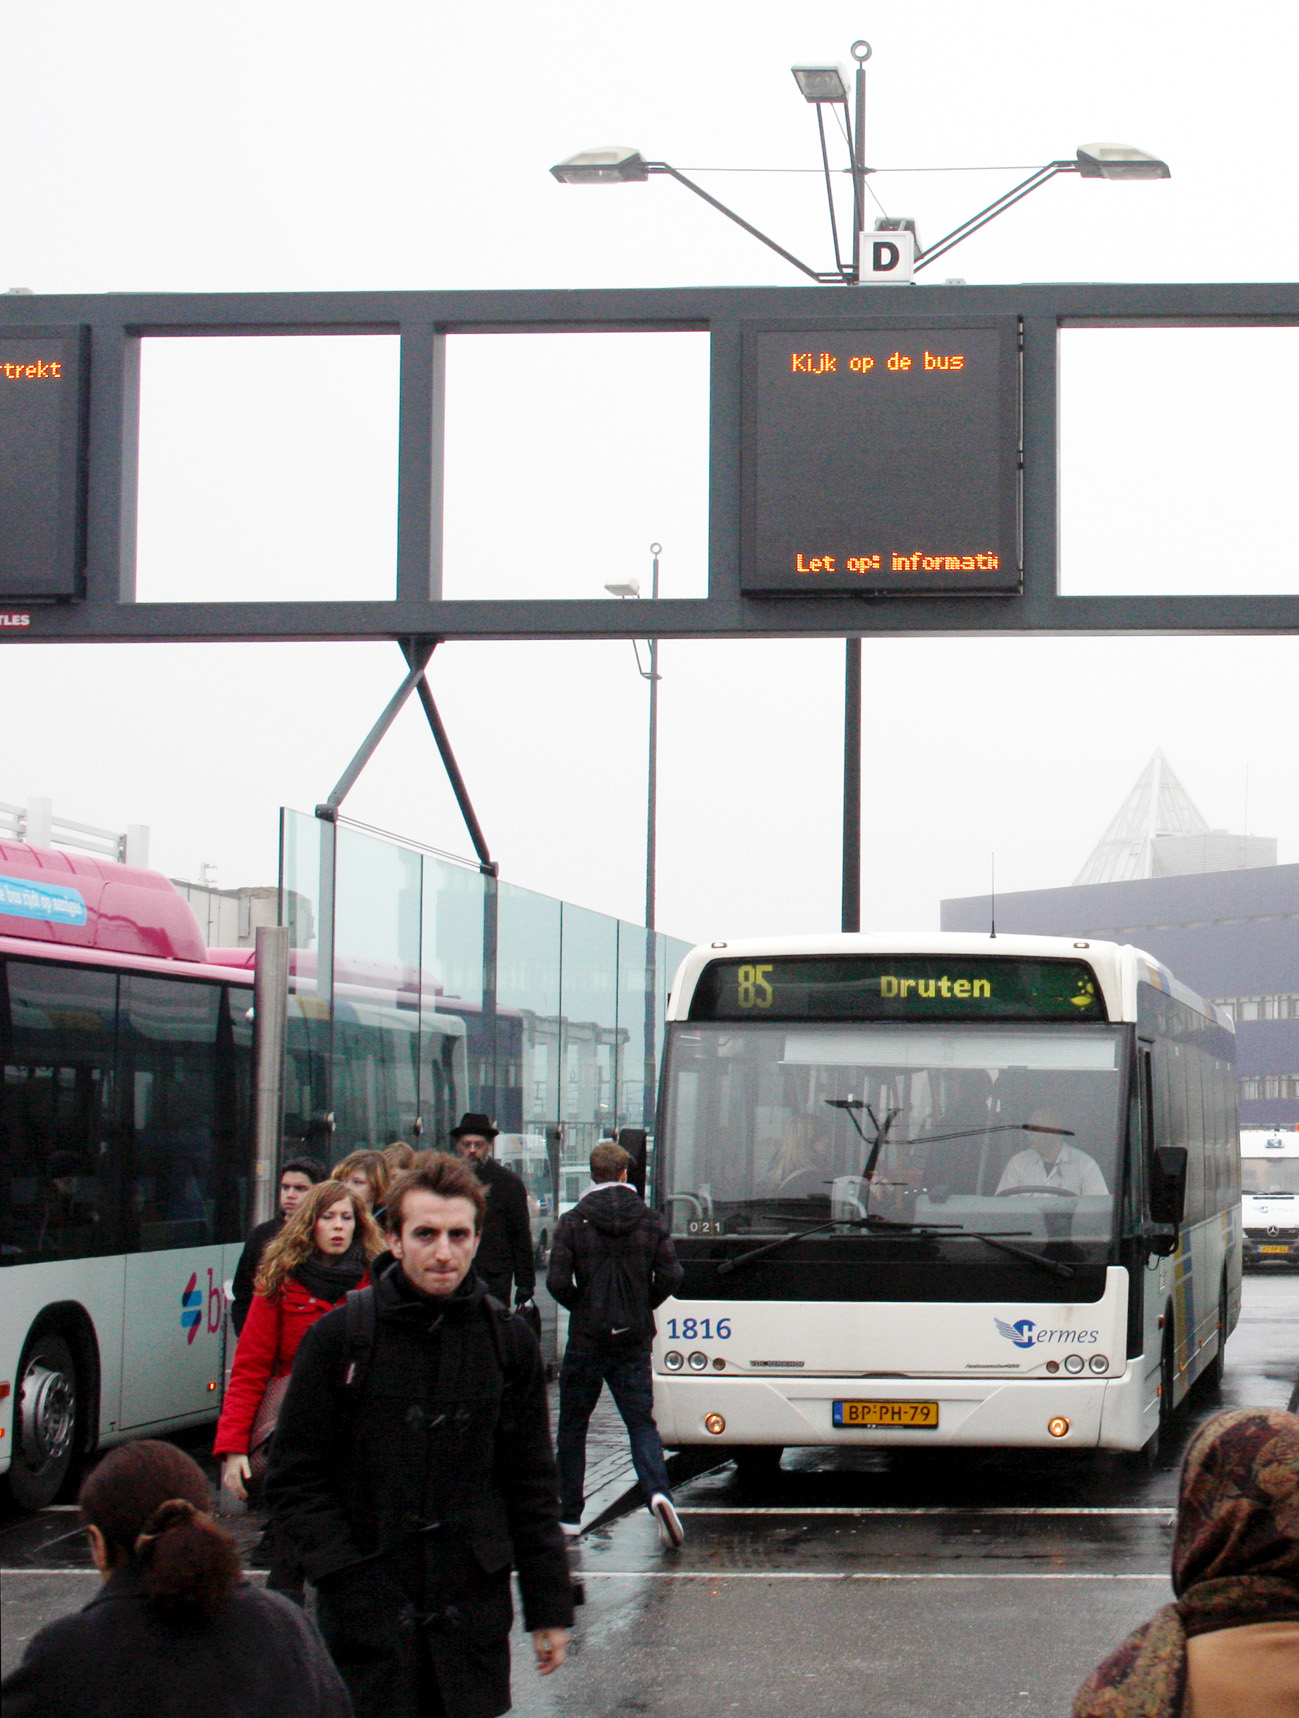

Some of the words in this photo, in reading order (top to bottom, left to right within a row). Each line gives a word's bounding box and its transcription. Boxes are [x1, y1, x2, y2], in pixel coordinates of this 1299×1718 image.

[873, 241, 900, 271] D
[0, 360, 62, 379] trekt
[792, 353, 837, 374] Kijk
[850, 356, 874, 374] op
[887, 352, 912, 371] de
[924, 351, 965, 370] bus
[796, 553, 836, 572] Let
[846, 554, 880, 574] op:
[738, 964, 773, 1009] 85
[880, 975, 991, 998] Druten
[666, 1318, 732, 1340] 1816
[1021, 1324, 1099, 1344] Hermes
[849, 1405, 931, 1421] BP-PH-79
